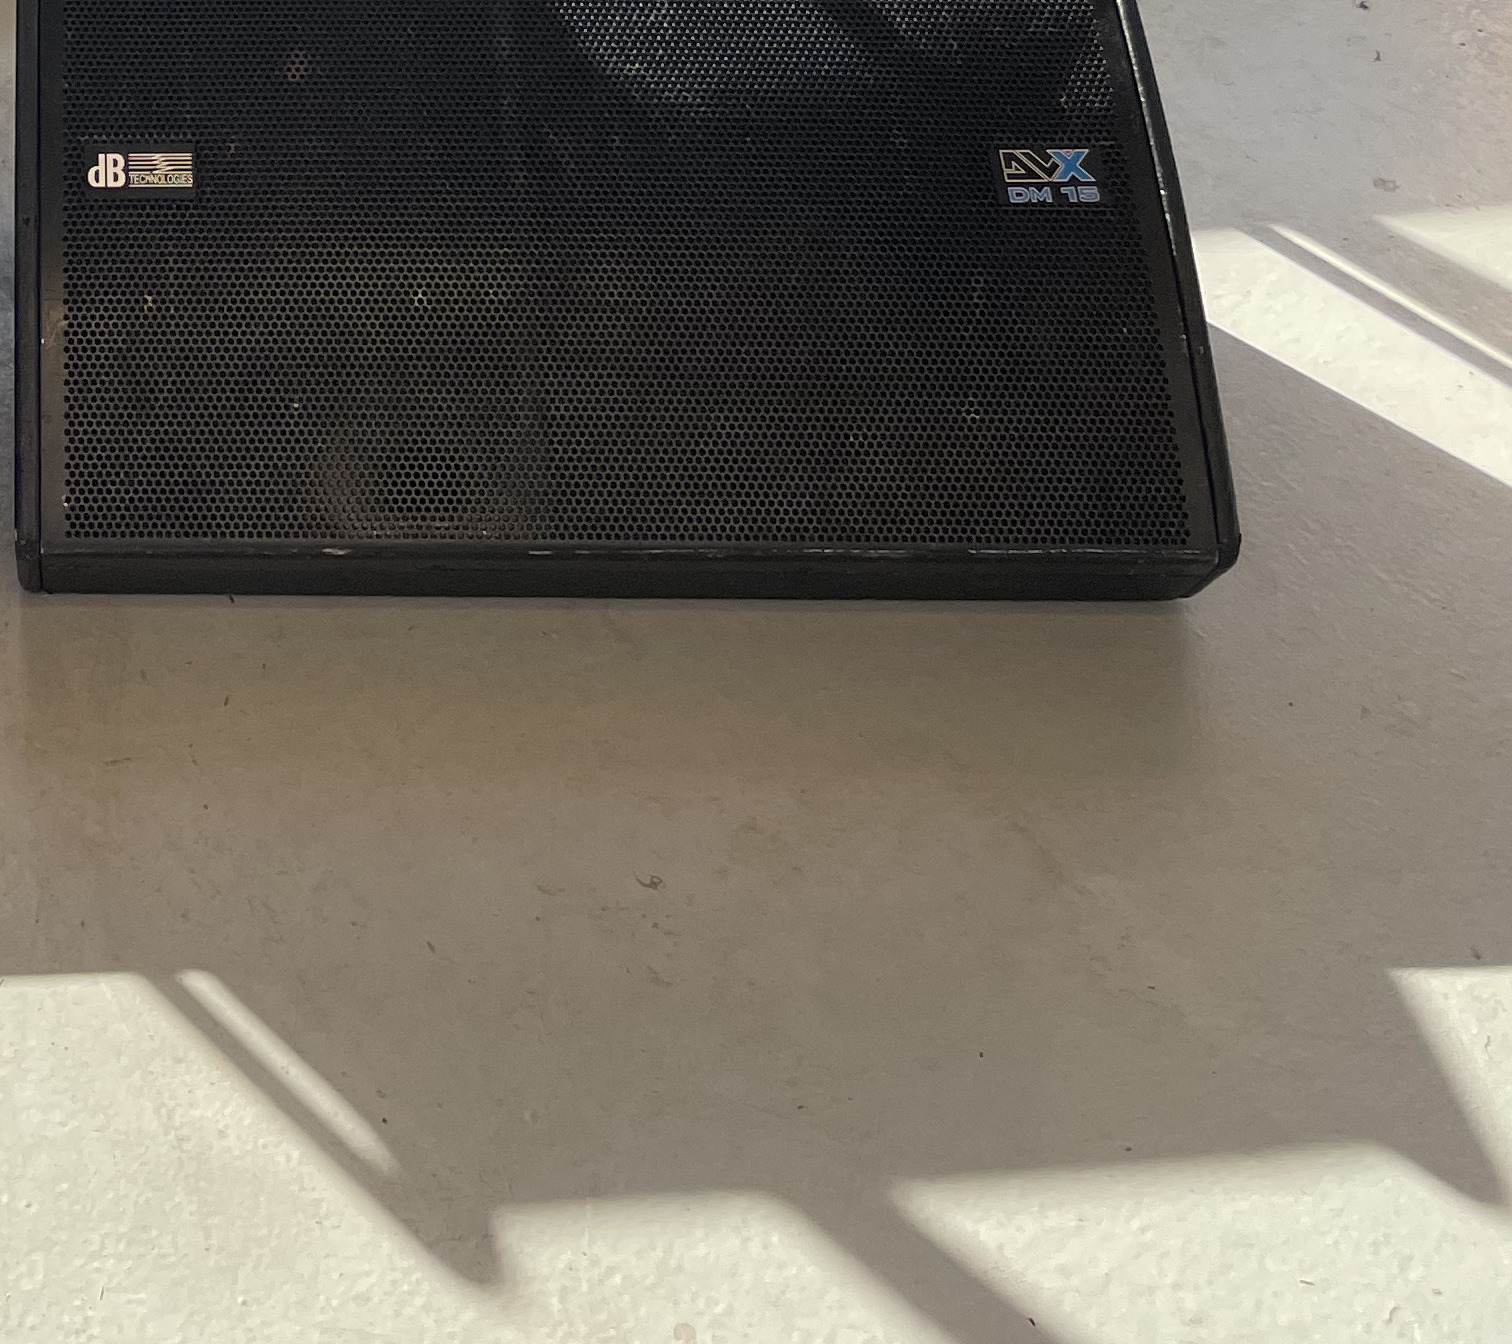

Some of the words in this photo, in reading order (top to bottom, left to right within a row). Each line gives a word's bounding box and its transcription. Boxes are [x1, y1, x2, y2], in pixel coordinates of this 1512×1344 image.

[88, 153, 126, 188] dB
[129, 173, 193, 185] TECHNOLOGIES
[1007, 186, 1053, 204] DM
[1060, 185, 1101, 203] 15
